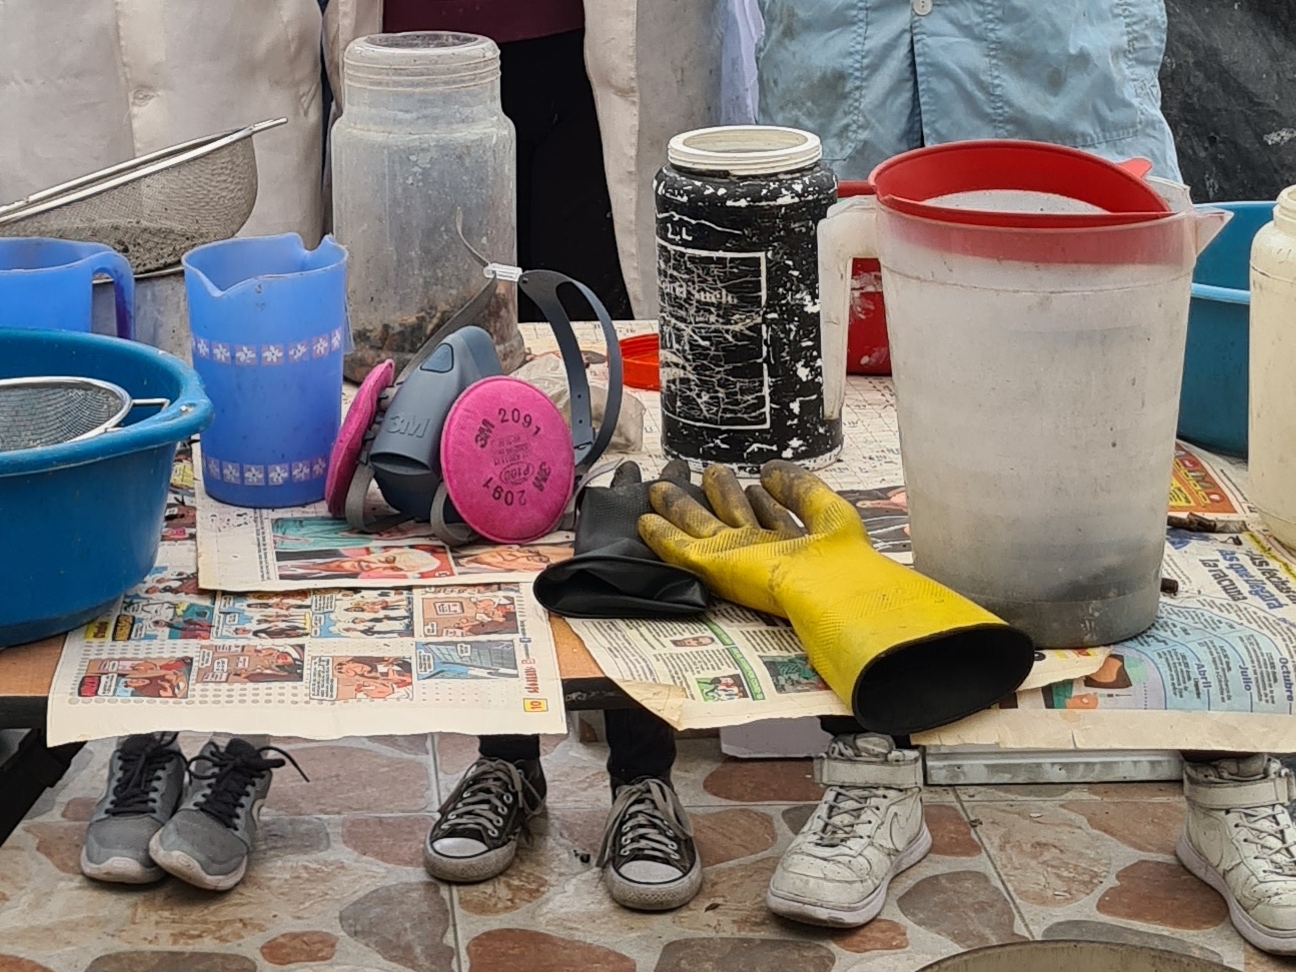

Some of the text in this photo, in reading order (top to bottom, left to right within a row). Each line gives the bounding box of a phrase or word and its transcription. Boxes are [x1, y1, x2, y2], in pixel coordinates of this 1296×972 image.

[475, 408, 542, 449] 3M 2091
[482, 476, 527, 506] 2091
[530, 700, 543, 710] 10
